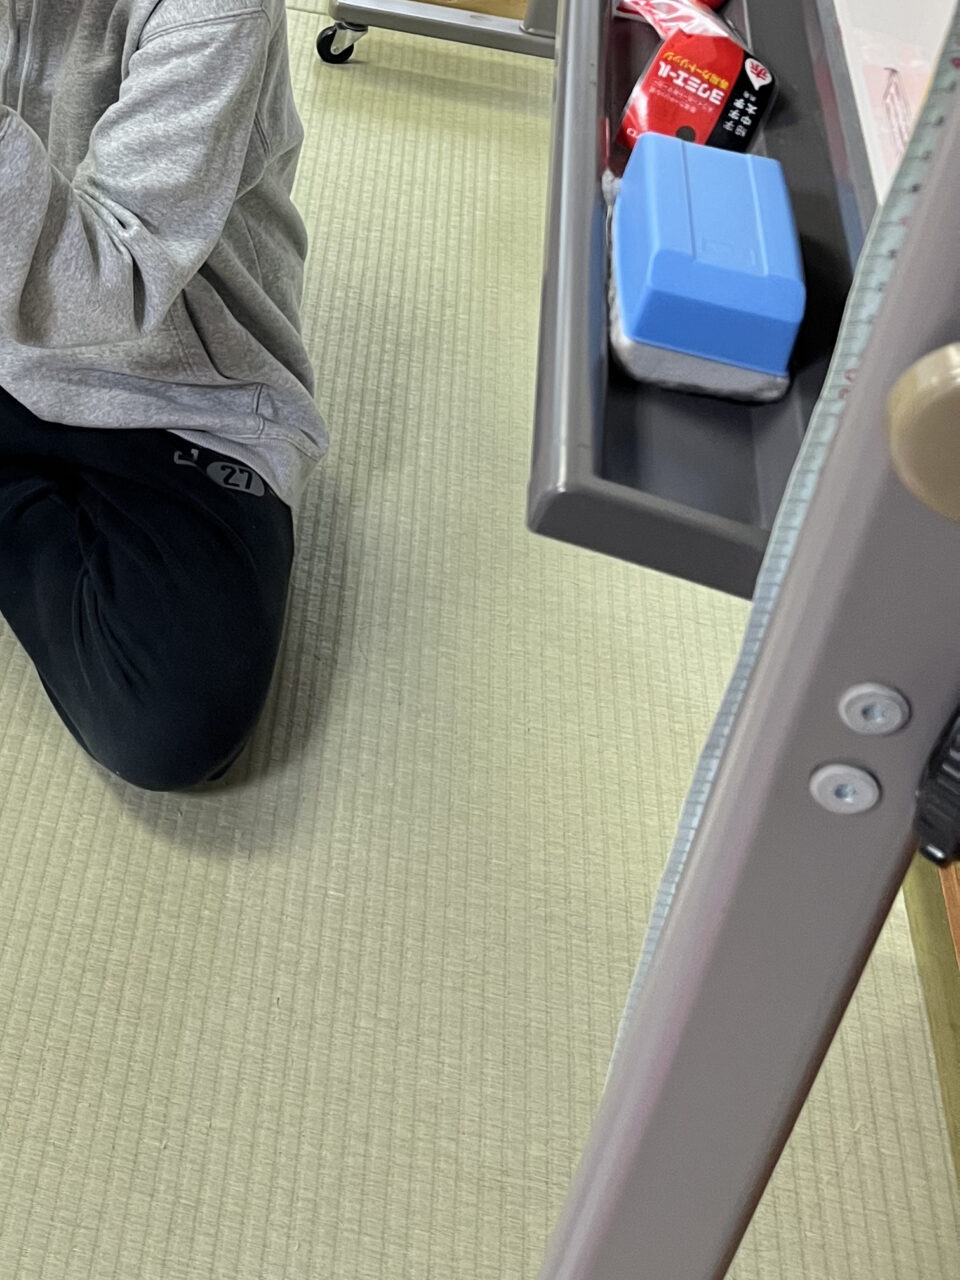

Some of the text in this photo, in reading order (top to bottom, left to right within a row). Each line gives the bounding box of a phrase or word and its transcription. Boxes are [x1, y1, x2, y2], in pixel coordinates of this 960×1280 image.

[749, 58, 768, 81] 赤
[657, 60, 726, 106] ヨクミエール
[220, 464, 254, 490] 27
